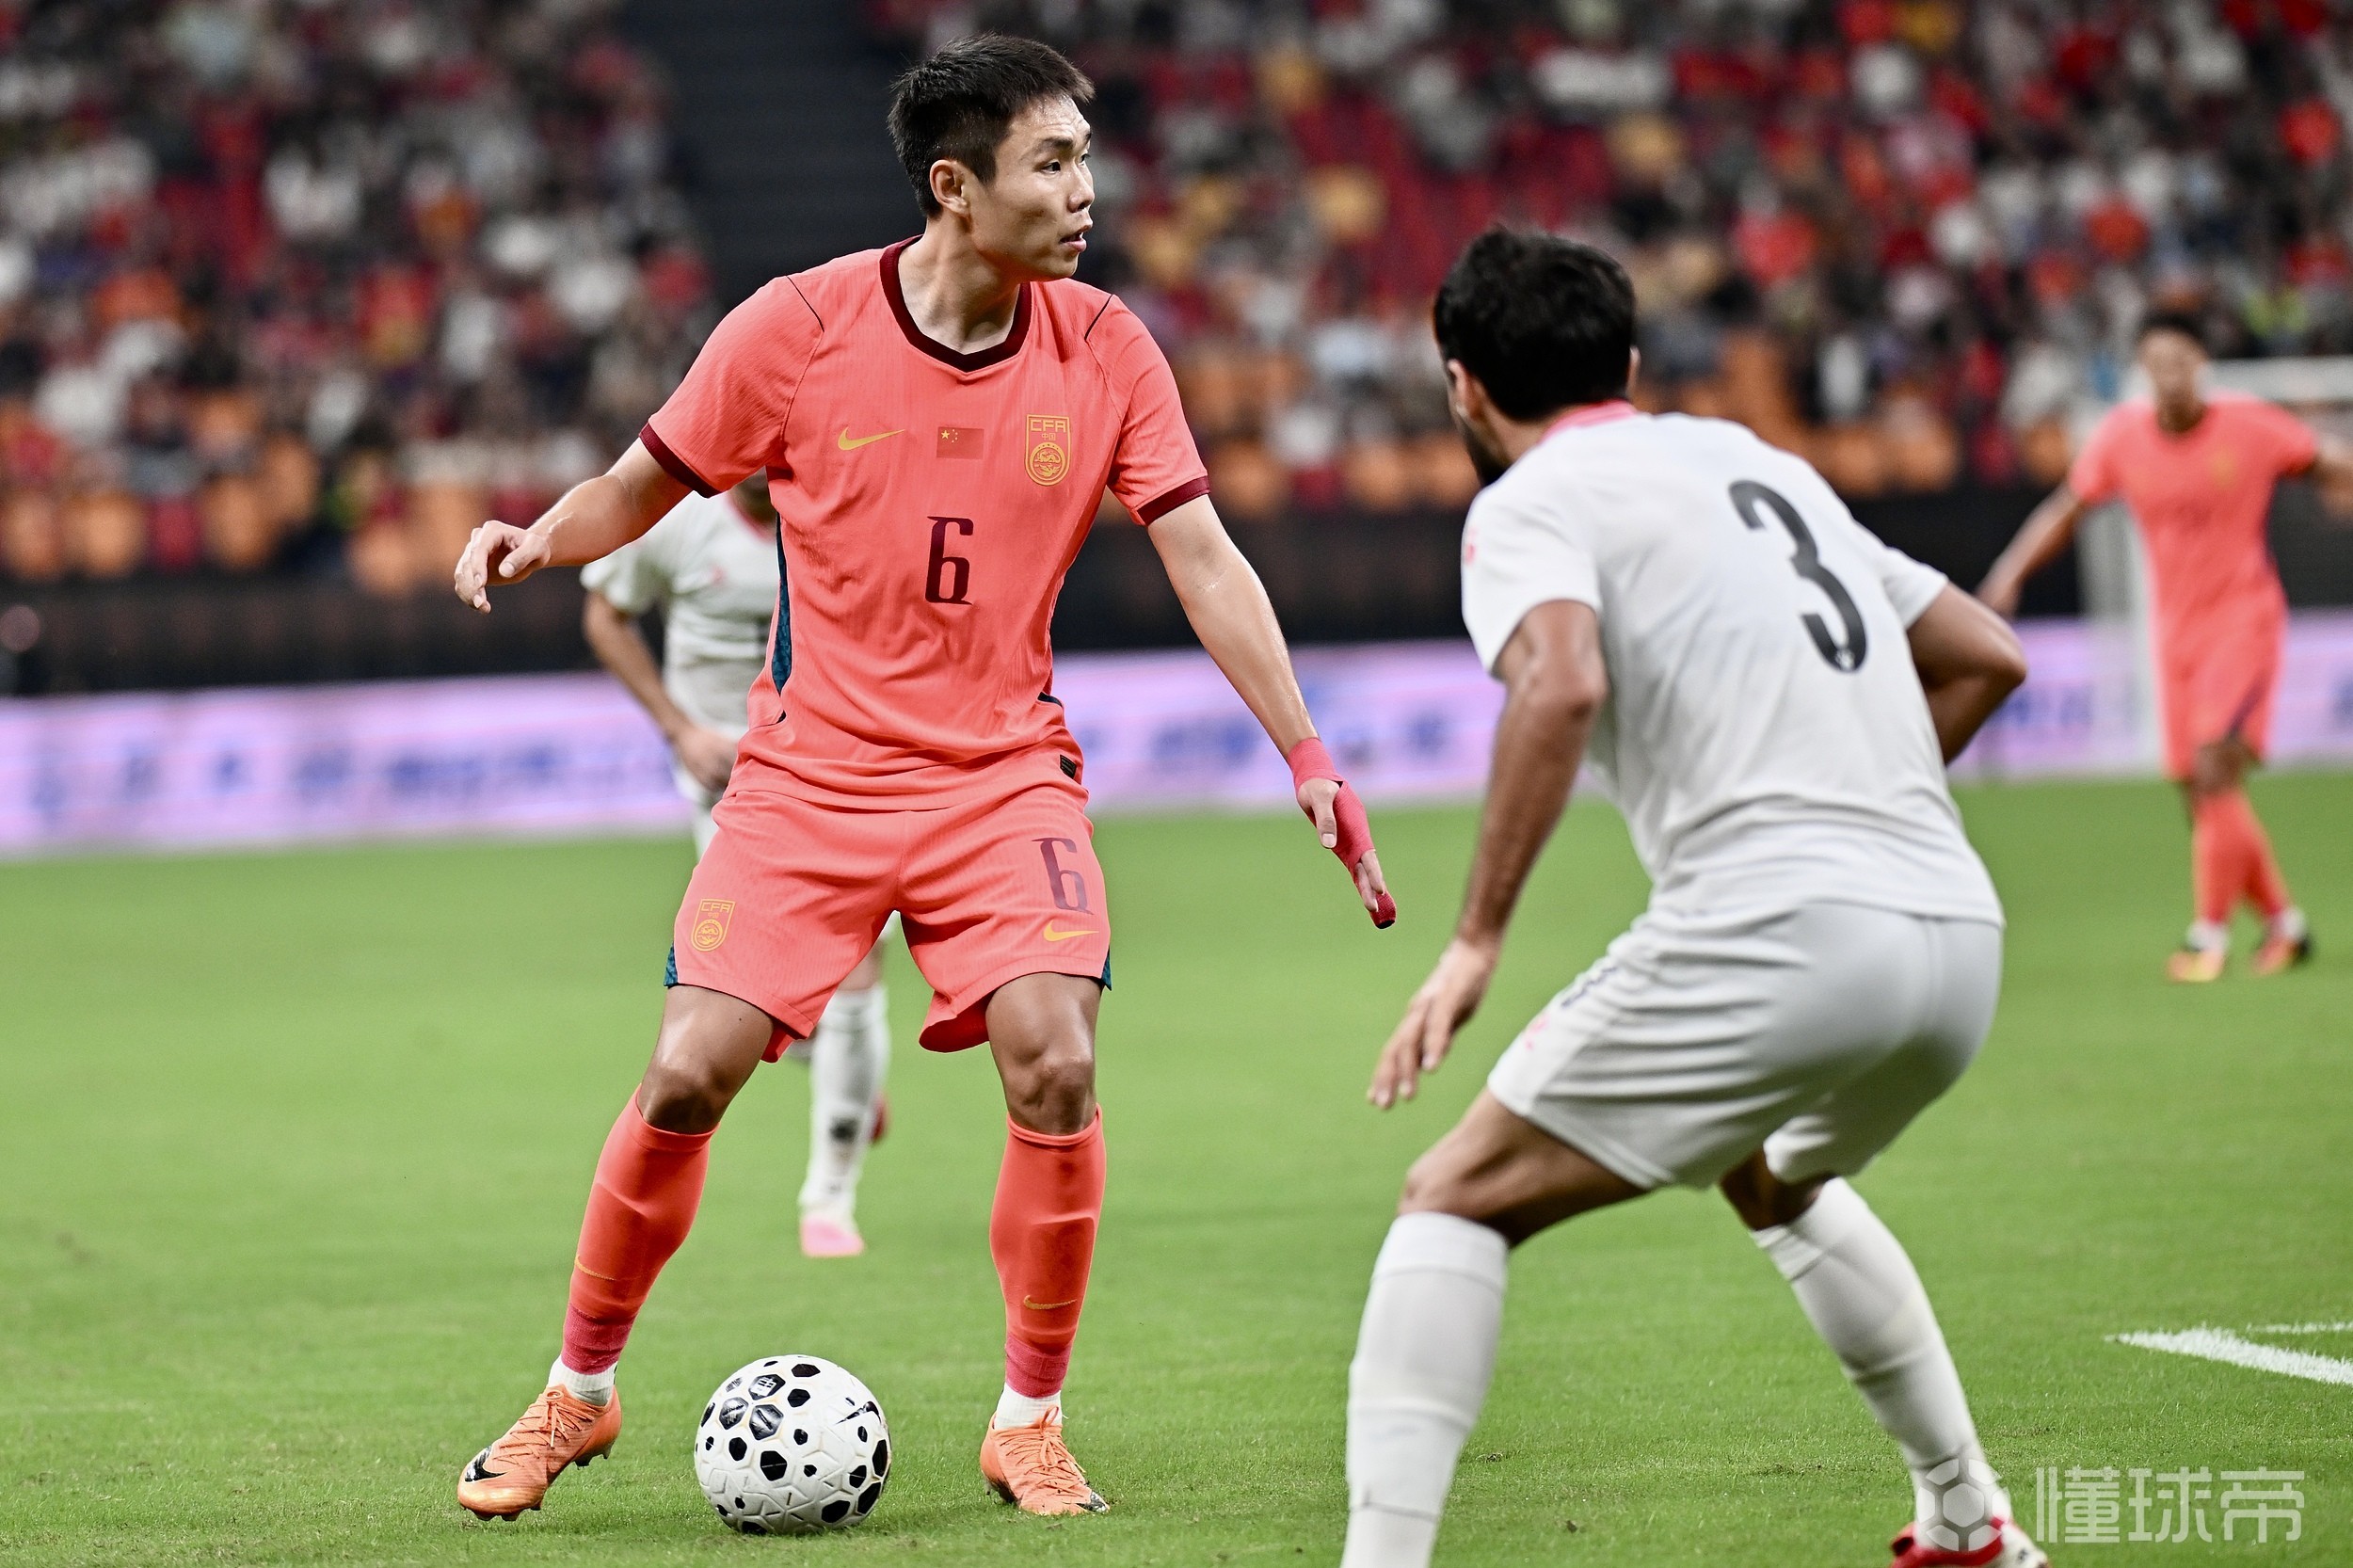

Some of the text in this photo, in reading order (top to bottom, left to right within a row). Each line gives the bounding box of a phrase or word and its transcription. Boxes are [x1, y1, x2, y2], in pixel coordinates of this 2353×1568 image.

[1030, 419, 1066, 433] CFA
[925, 516, 973, 605] 6
[1728, 479, 1868, 674] 3
[700, 902, 732, 913] CFA
[1031, 837, 1095, 915] 6
